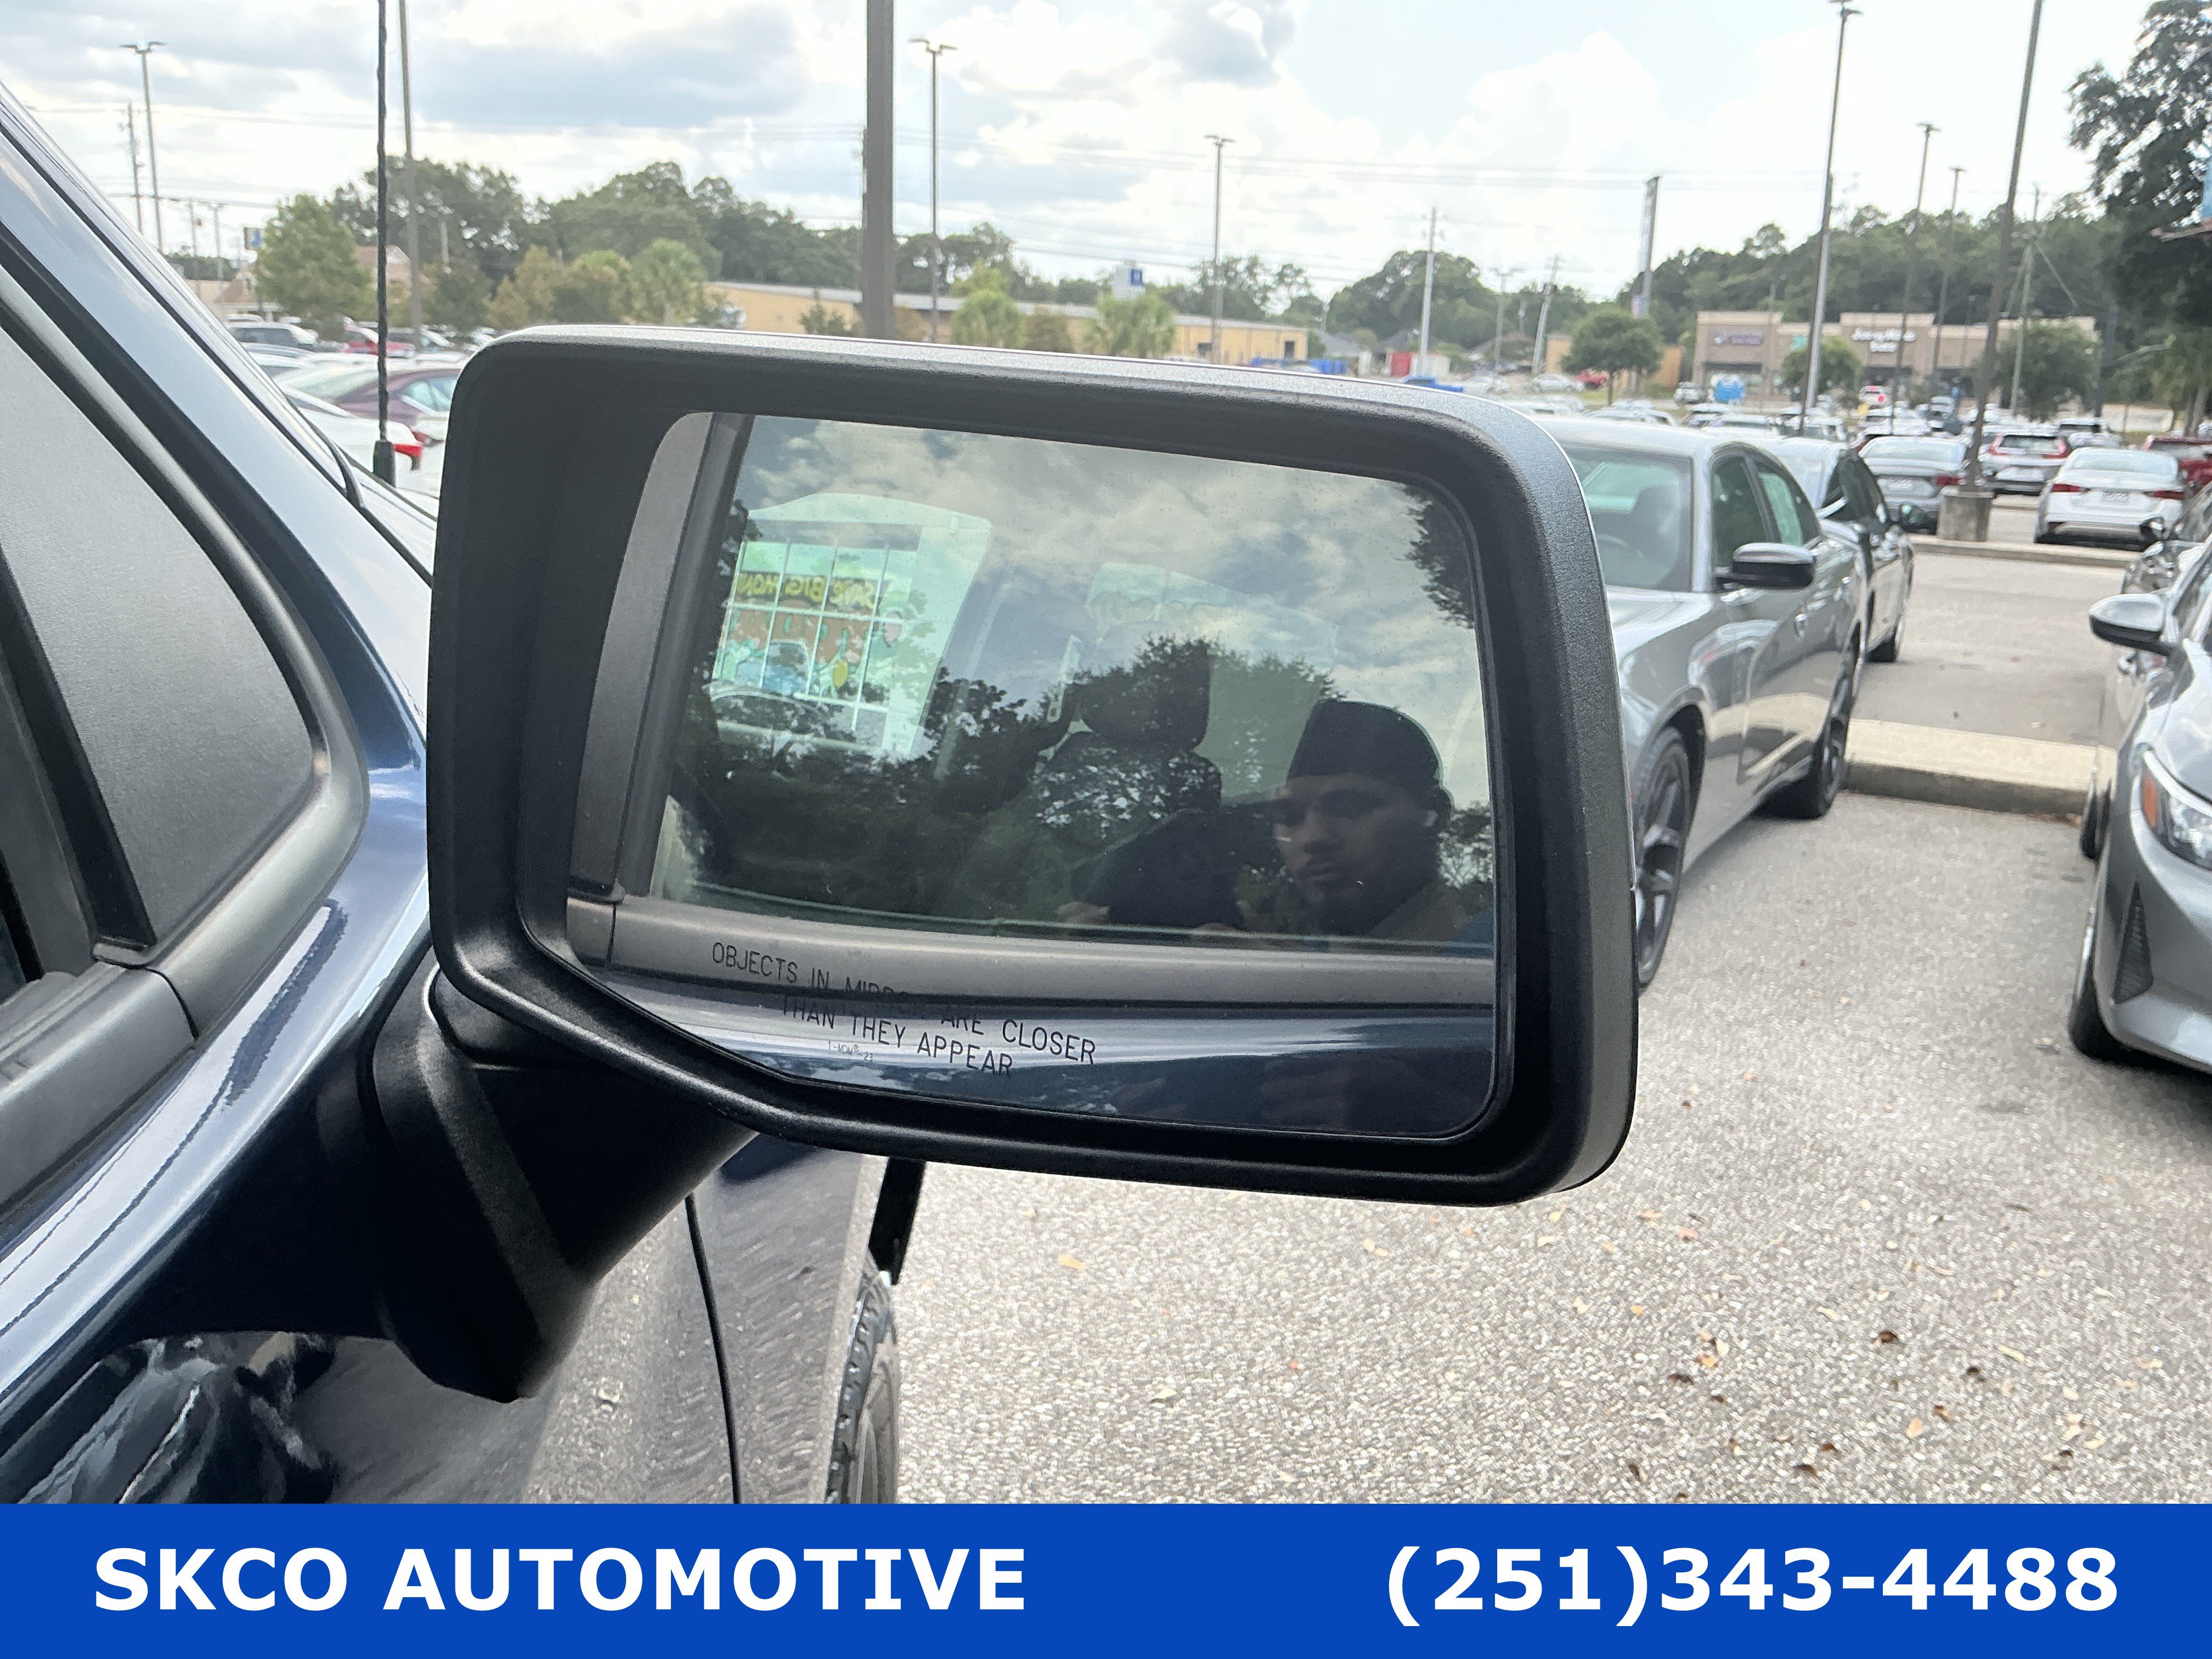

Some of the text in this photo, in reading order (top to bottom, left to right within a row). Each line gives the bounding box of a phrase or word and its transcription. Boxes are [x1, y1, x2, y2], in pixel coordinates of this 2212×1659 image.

[713, 942, 798, 984] OBJECTS
[810, 967, 830, 990] IN
[1002, 1018, 1096, 1065] CLOSER
[850, 1013, 906, 1048] THEY
[917, 1031, 1013, 1076] APPEAR
